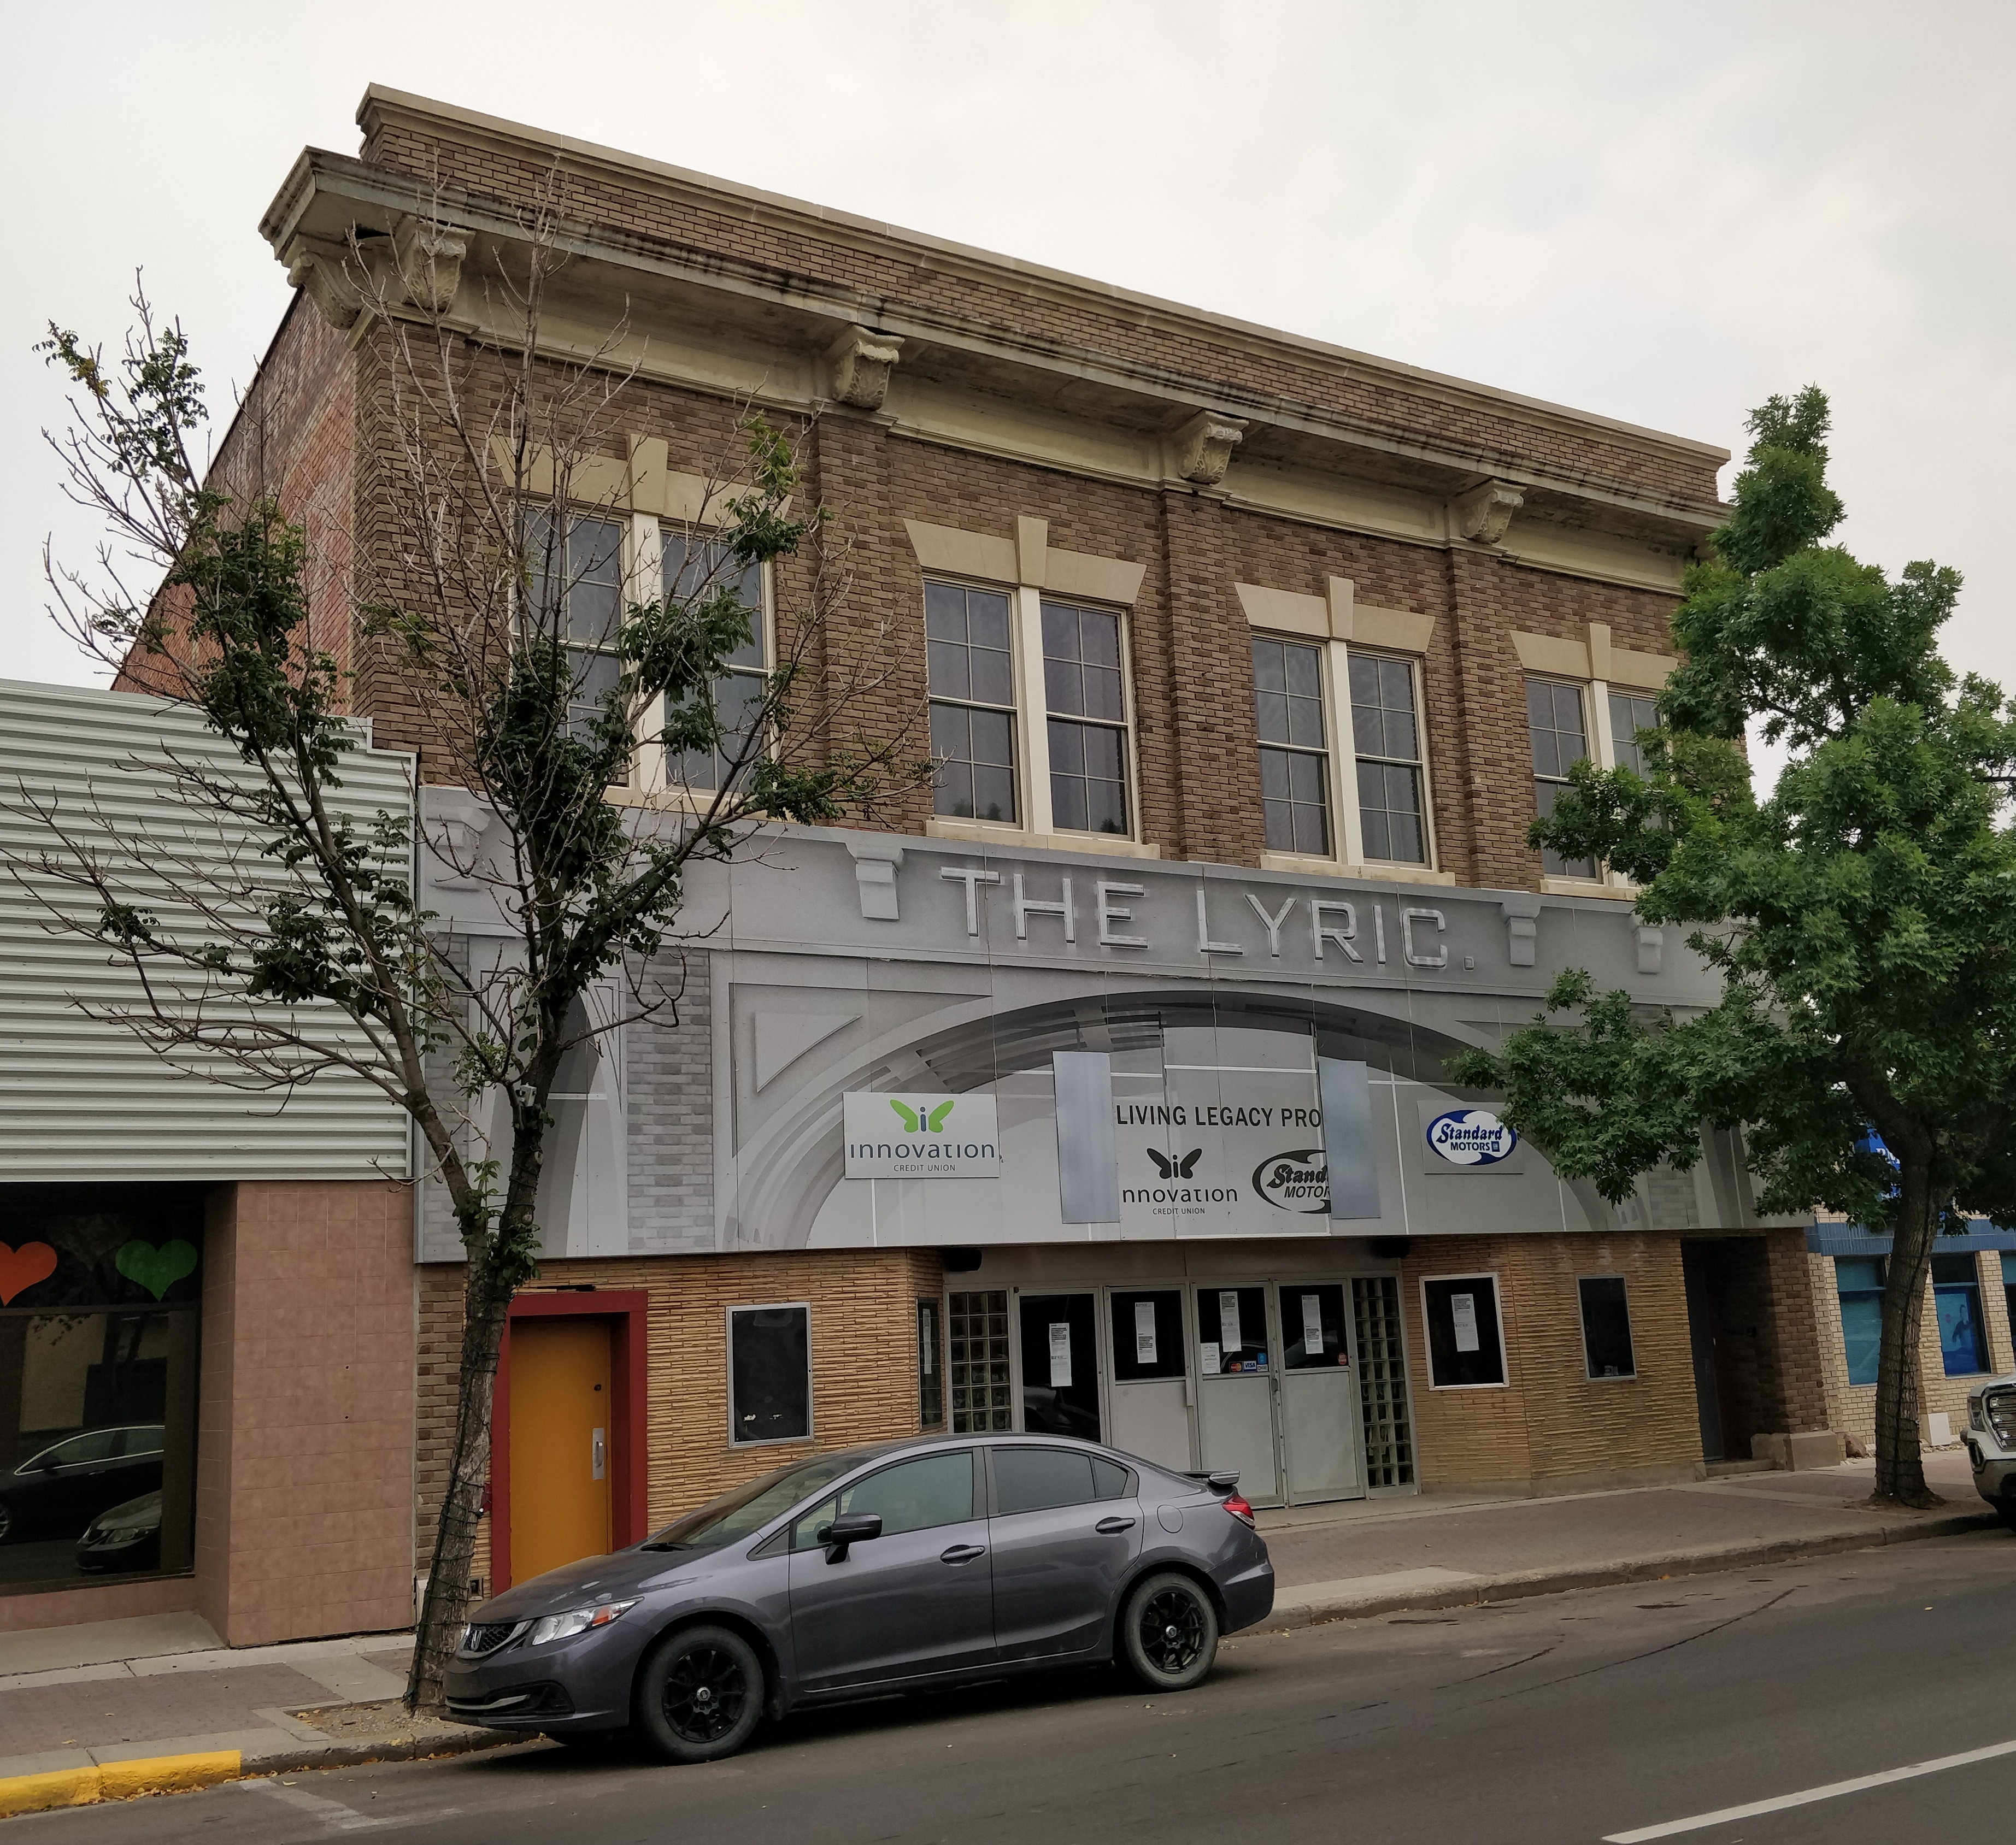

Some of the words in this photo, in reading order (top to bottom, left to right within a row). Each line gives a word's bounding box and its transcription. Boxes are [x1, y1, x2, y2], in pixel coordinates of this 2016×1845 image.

[941, 866, 1148, 948] THE
[1116, 1105, 1186, 1125] LIVING
[1195, 1106, 1273, 1127] LEGACY
[1281, 1109, 1321, 1127] PRO
[1436, 1123, 1503, 1143] Standard
[850, 1144, 995, 1158] innovation
[1450, 1142, 1490, 1151] MOTORS
[1266, 1164, 1329, 1188] Stand
[1122, 1188, 1238, 1203] nnovation
